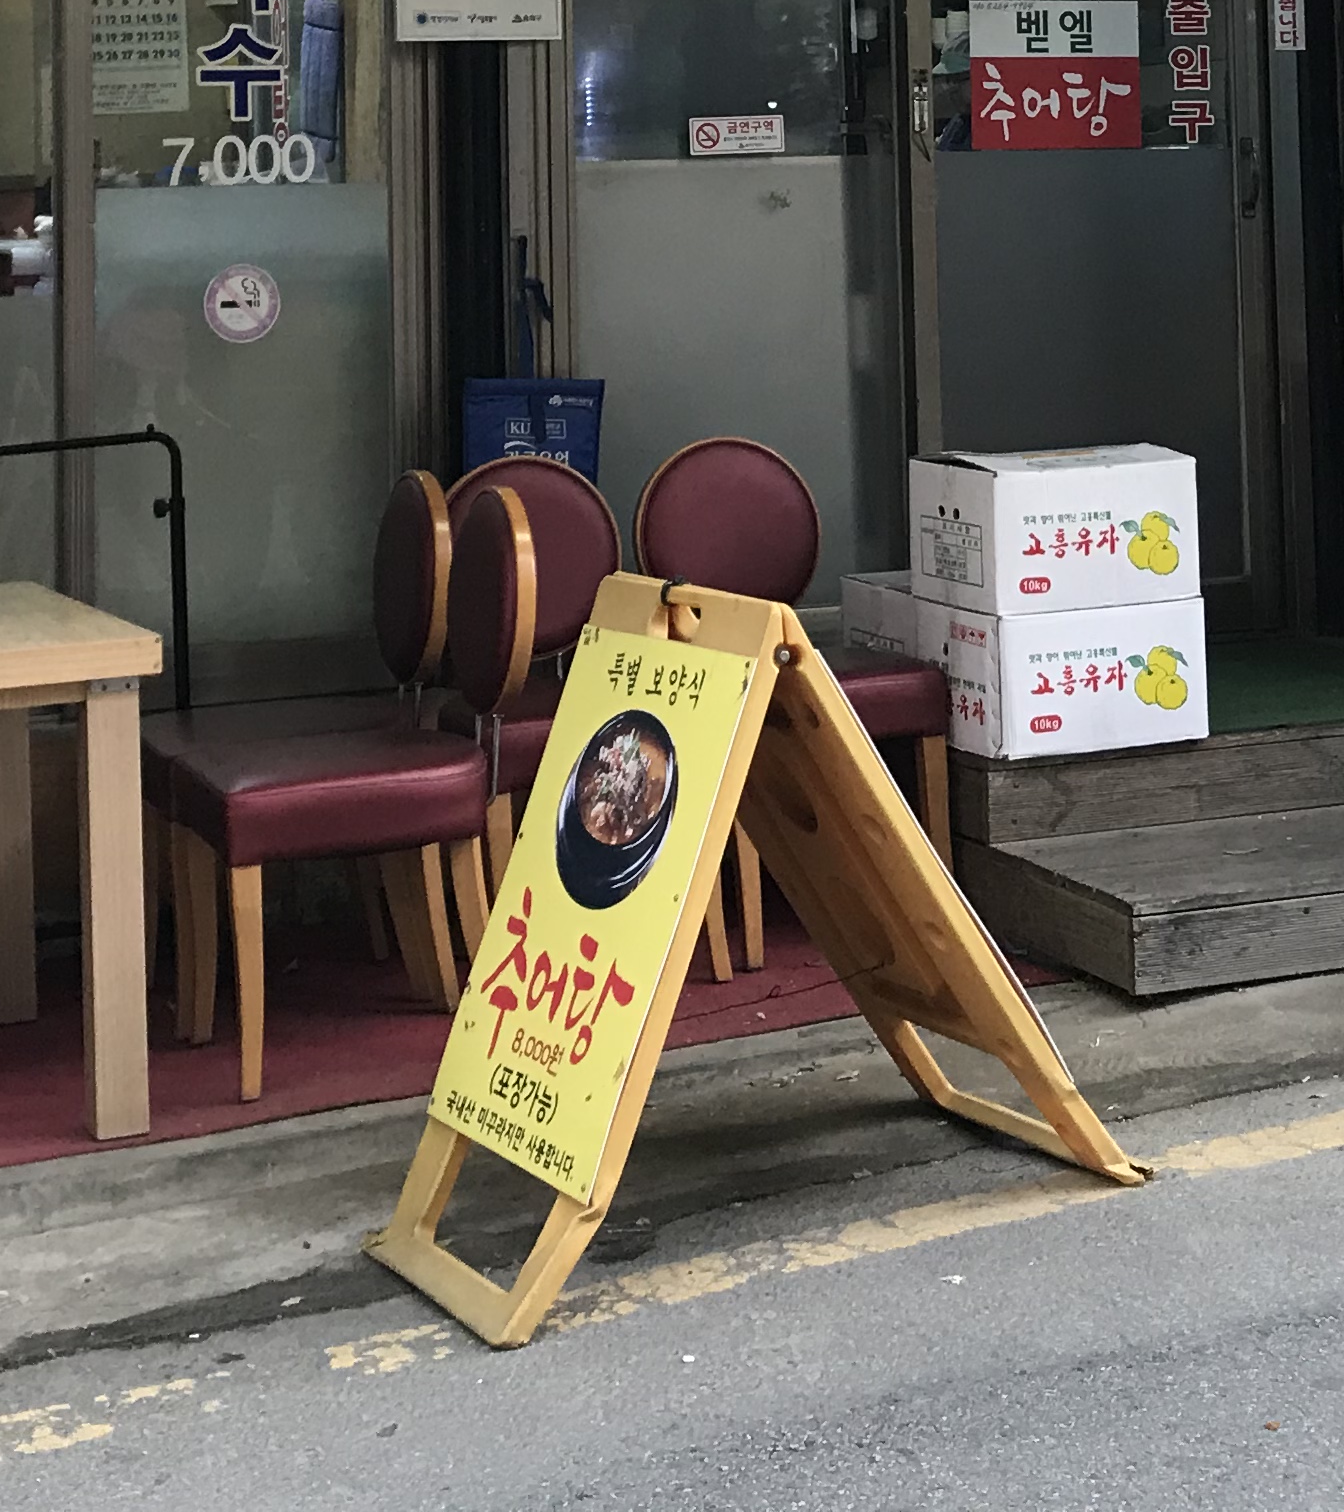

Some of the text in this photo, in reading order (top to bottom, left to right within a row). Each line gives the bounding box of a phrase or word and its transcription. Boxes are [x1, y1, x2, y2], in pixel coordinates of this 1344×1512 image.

[726, 119, 775, 134] 금연구역
[980, 62, 1131, 141] 추어탕
[162, 134, 315, 186] 7,000
[1022, 523, 1121, 559] 고흥유자
[1023, 579, 1048, 592] 10kg
[607, 652, 707, 710] 특별 보양식
[1030, 659, 1128, 696] 고흥유자
[1034, 718, 1059, 731] 10kg
[481, 886, 635, 1066] 추어탕
[511, 1026, 565, 1077] 8,000원
[488, 1062, 559, 1126] (포장가능)
[445, 1089, 477, 1124] 국내산
[477, 1106, 526, 1152] 미꾸라지만
